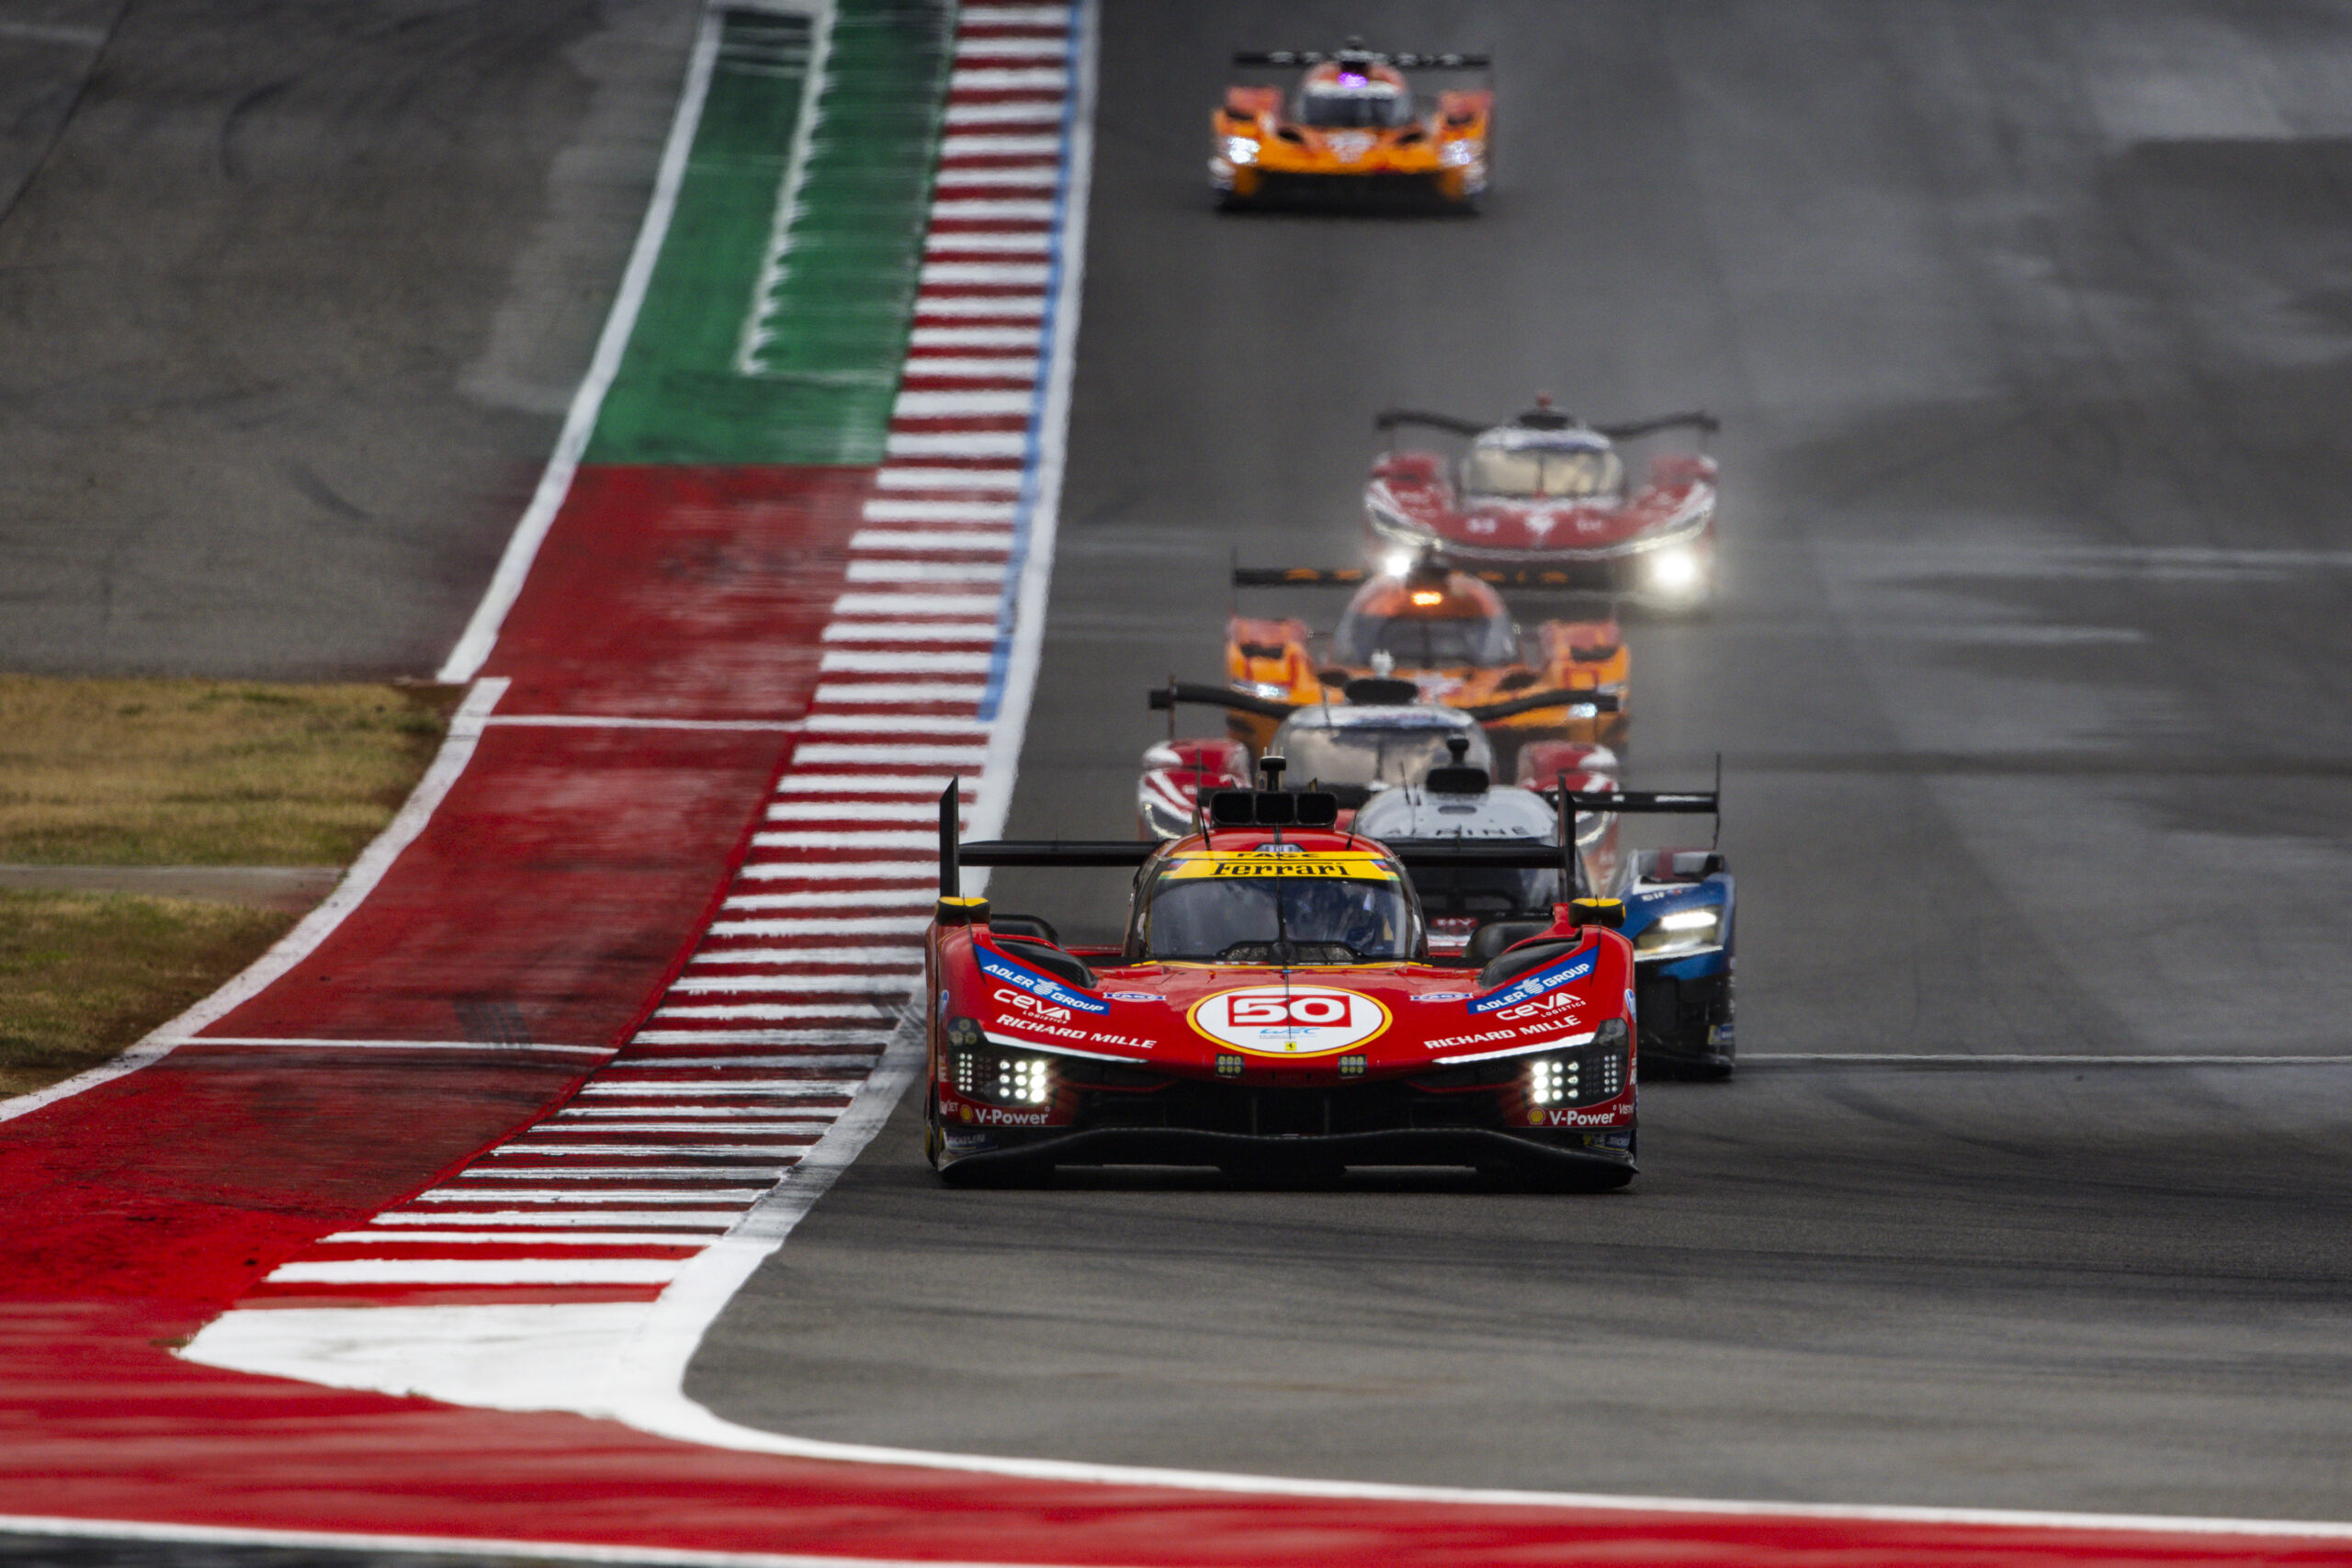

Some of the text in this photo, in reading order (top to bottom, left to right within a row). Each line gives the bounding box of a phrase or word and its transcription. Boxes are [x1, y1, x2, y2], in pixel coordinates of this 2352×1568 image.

[1211, 861, 1351, 876] Ferrari
[983, 964, 1105, 1011] ADLER GROUP
[1476, 963, 1590, 1012] ADLER GROUP
[1022, 1010, 1068, 1024] LOGISTICS
[1233, 997, 1345, 1023] 50
[1540, 1000, 1587, 1019] LOGISTICS
[996, 1013, 1158, 1049] RICHARD MILLE
[1423, 1014, 1582, 1050] RICHARD MILLE
[975, 1108, 1049, 1125] V-Power
[1549, 1111, 1615, 1126] V-Power
